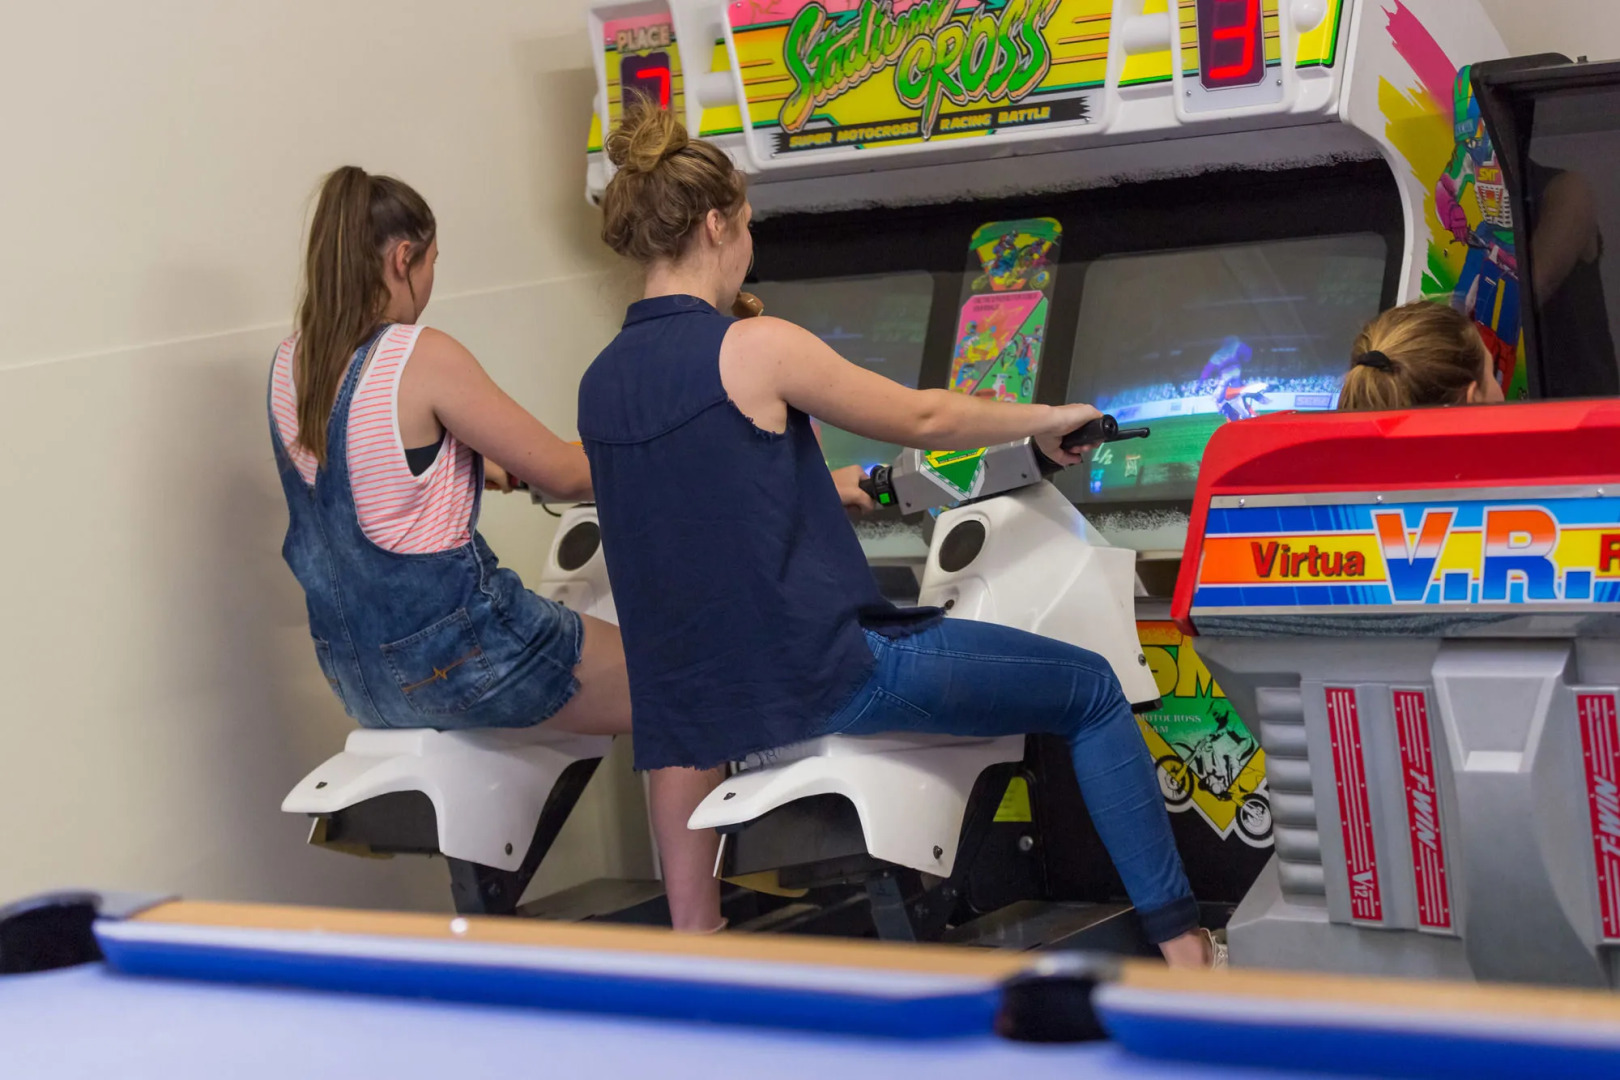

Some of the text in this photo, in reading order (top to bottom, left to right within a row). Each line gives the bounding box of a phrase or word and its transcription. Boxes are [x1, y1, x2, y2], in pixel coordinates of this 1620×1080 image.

[615, 23, 672, 54] PLACE
[779, 0, 956, 132] Stadium
[894, 0, 1058, 138] CROSS
[1208, 0, 1260, 80] 3
[789, 106, 1051, 148] SUPER MOTOCROSS RACING BATTLE
[1250, 541, 1366, 579] Virtua
[1370, 505, 1597, 604] V.R.
[1137, 714, 1201, 722] MOTOCROSS
[1409, 768, 1437, 850] T-WIN
[1352, 870, 1375, 898] V12
